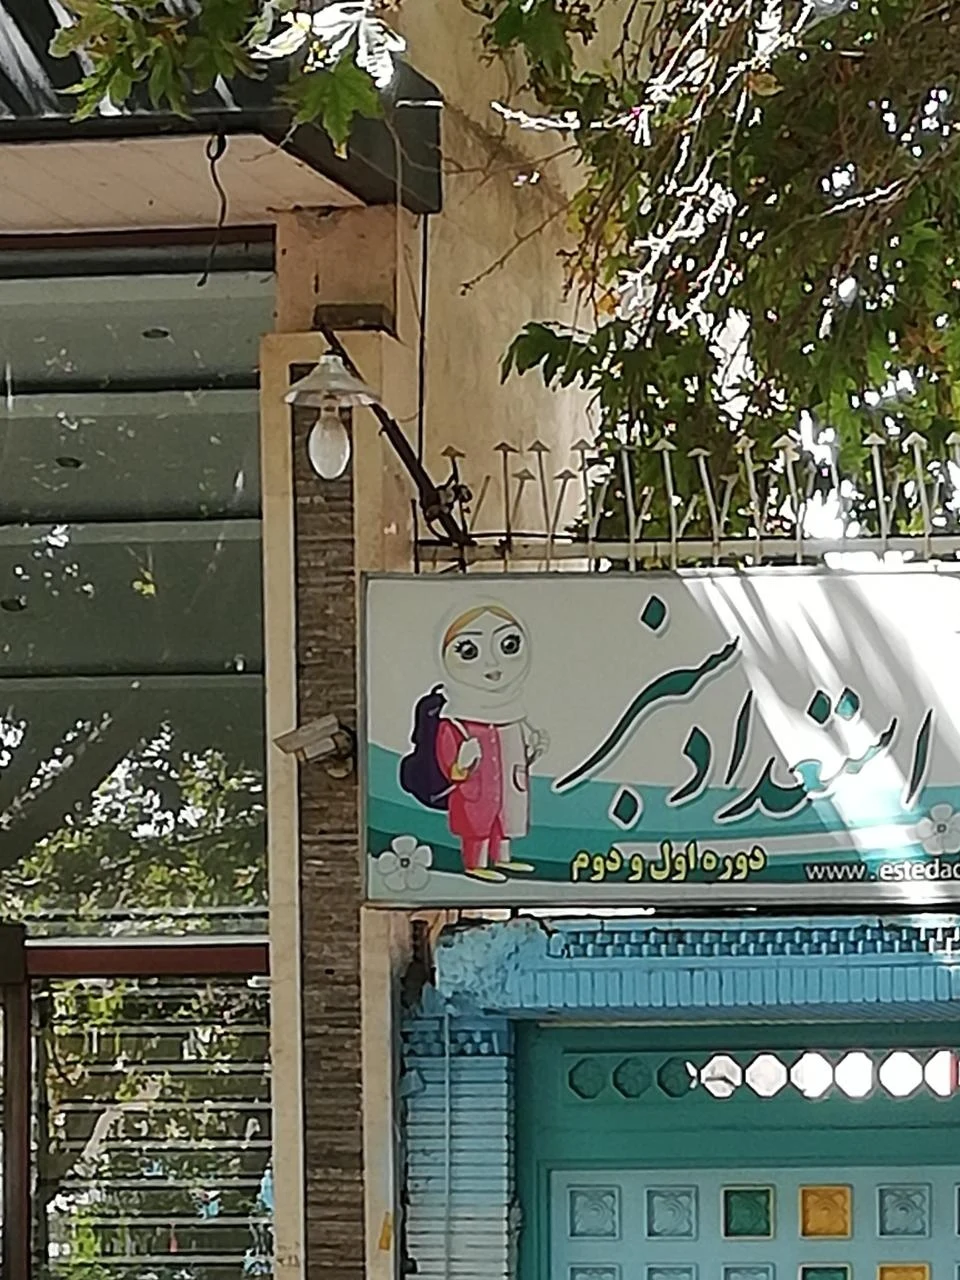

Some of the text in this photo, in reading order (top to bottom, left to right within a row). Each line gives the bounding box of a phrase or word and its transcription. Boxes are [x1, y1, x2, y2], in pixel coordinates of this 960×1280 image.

[570, 838, 767, 884] دوره اول و دوم
